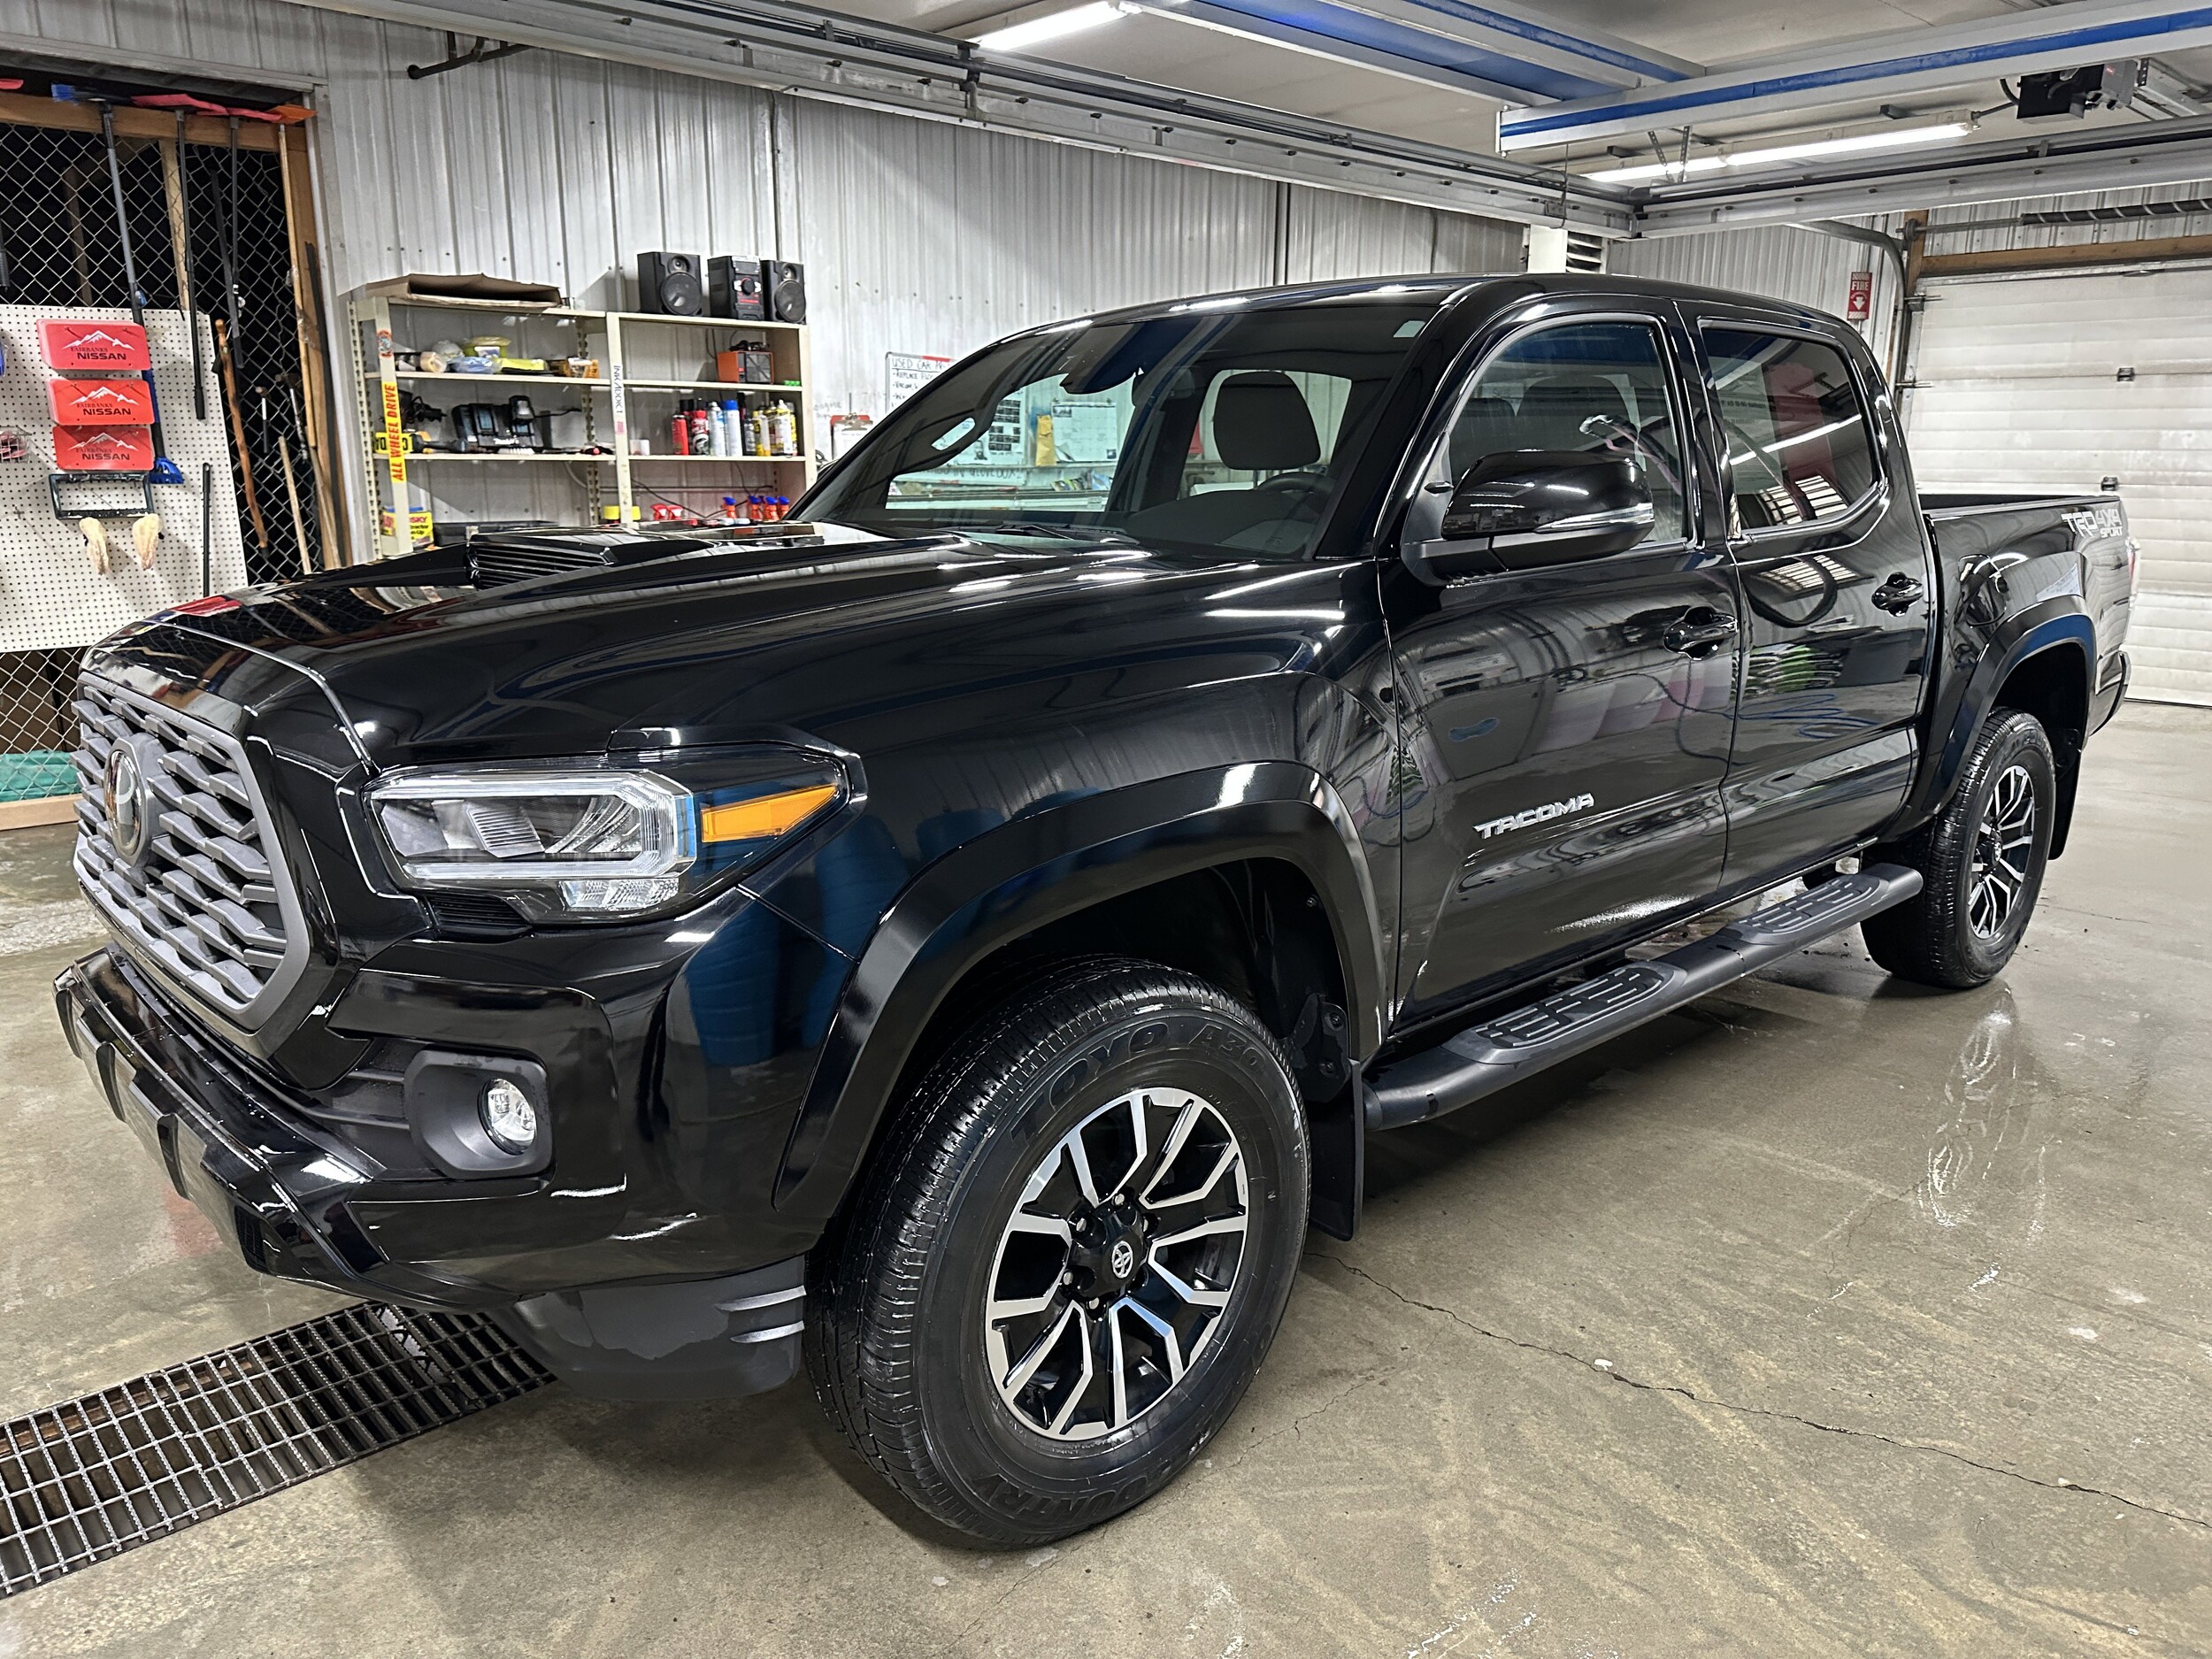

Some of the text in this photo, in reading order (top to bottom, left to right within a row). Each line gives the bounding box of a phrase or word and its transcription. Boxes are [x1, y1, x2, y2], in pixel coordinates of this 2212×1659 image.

[1851, 280, 1869, 291] FIRE
[384, 384, 397, 419] DRIVE
[388, 422, 402, 457] WHEEL
[391, 462, 403, 481] ALL
[2061, 511, 2098, 539] TRD
[2100, 526, 2123, 539] SPORT
[1472, 792, 1594, 840] TACOMA
[1010, 1021, 1170, 1148] TOYO
